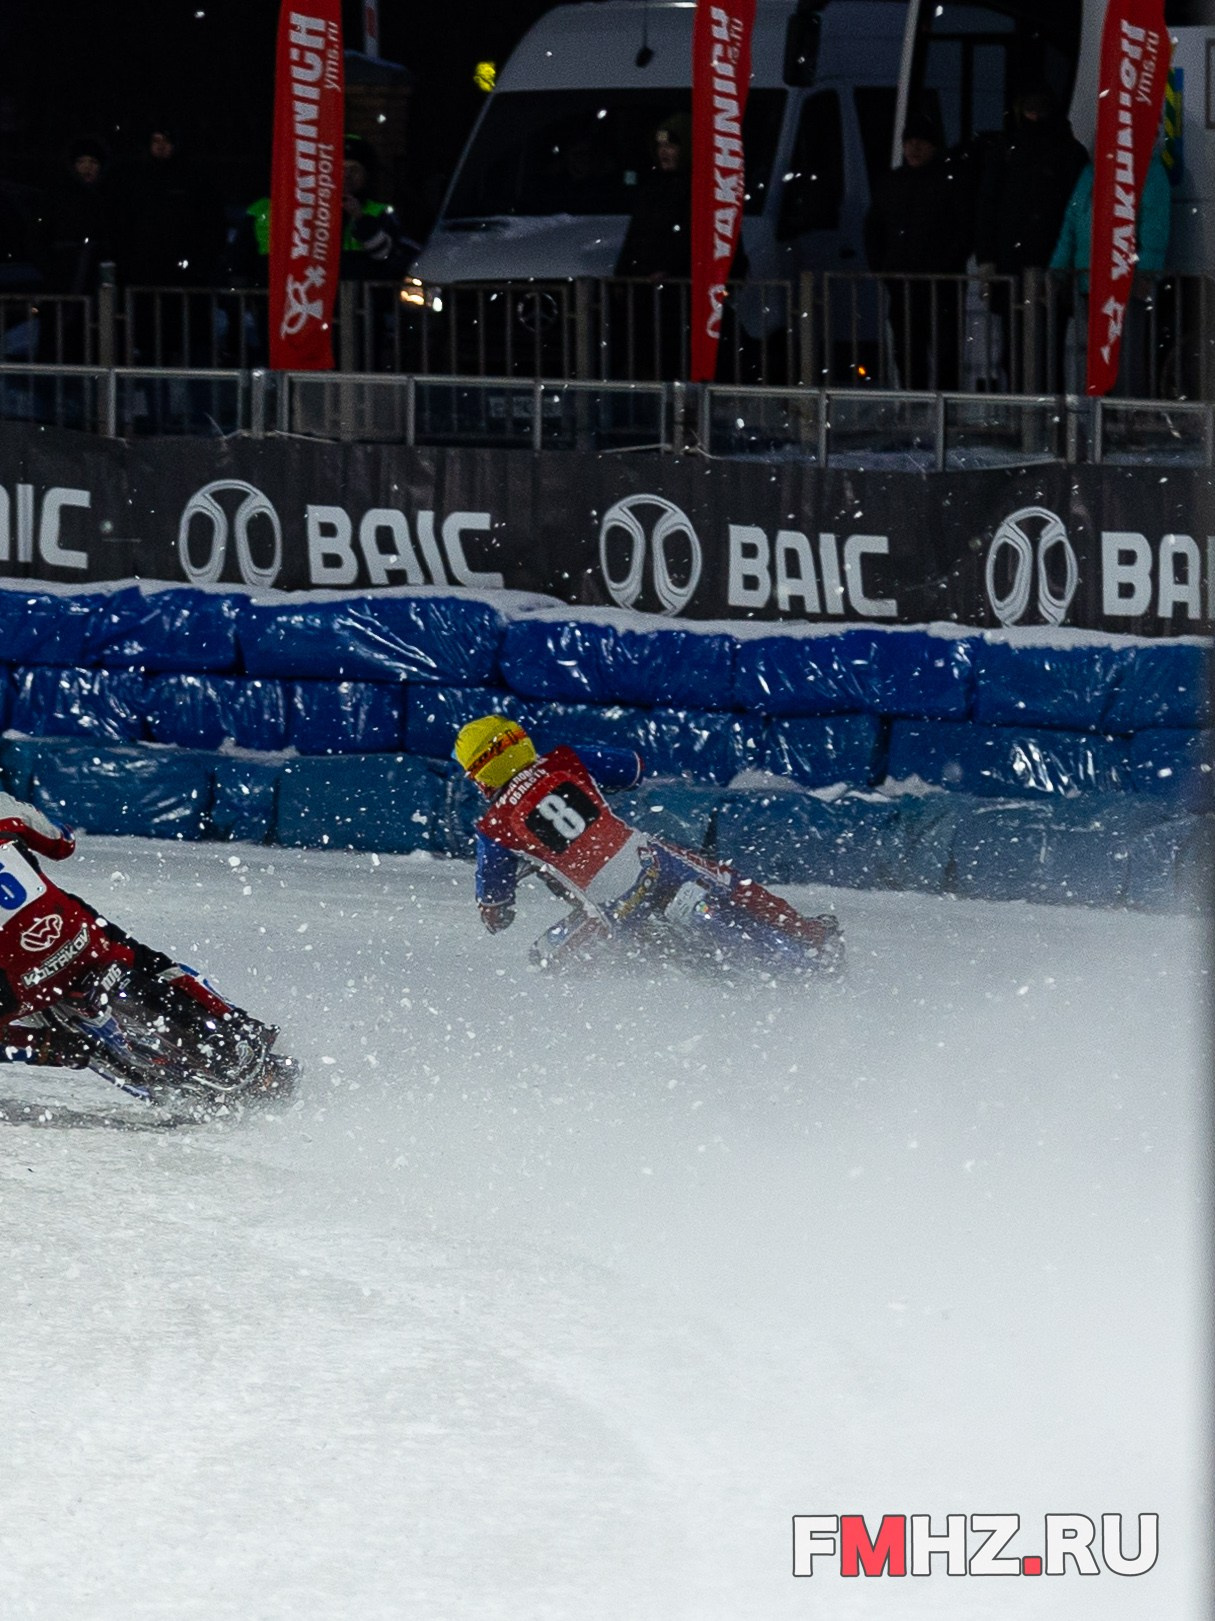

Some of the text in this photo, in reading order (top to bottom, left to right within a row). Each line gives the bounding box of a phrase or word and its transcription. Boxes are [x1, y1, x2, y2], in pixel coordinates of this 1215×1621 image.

[324, 20, 343, 93] yms.ru
[1135, 31, 1161, 107] yms.ru
[312, 143, 335, 262] motorsport
[306, 504, 505, 589] BAIC
[728, 524, 898, 617] BAIC
[509, 768, 548, 805] ОБЛАСТЬ
[538, 793, 586, 840] 8
[24, 928, 88, 986] KOLTAKOV
